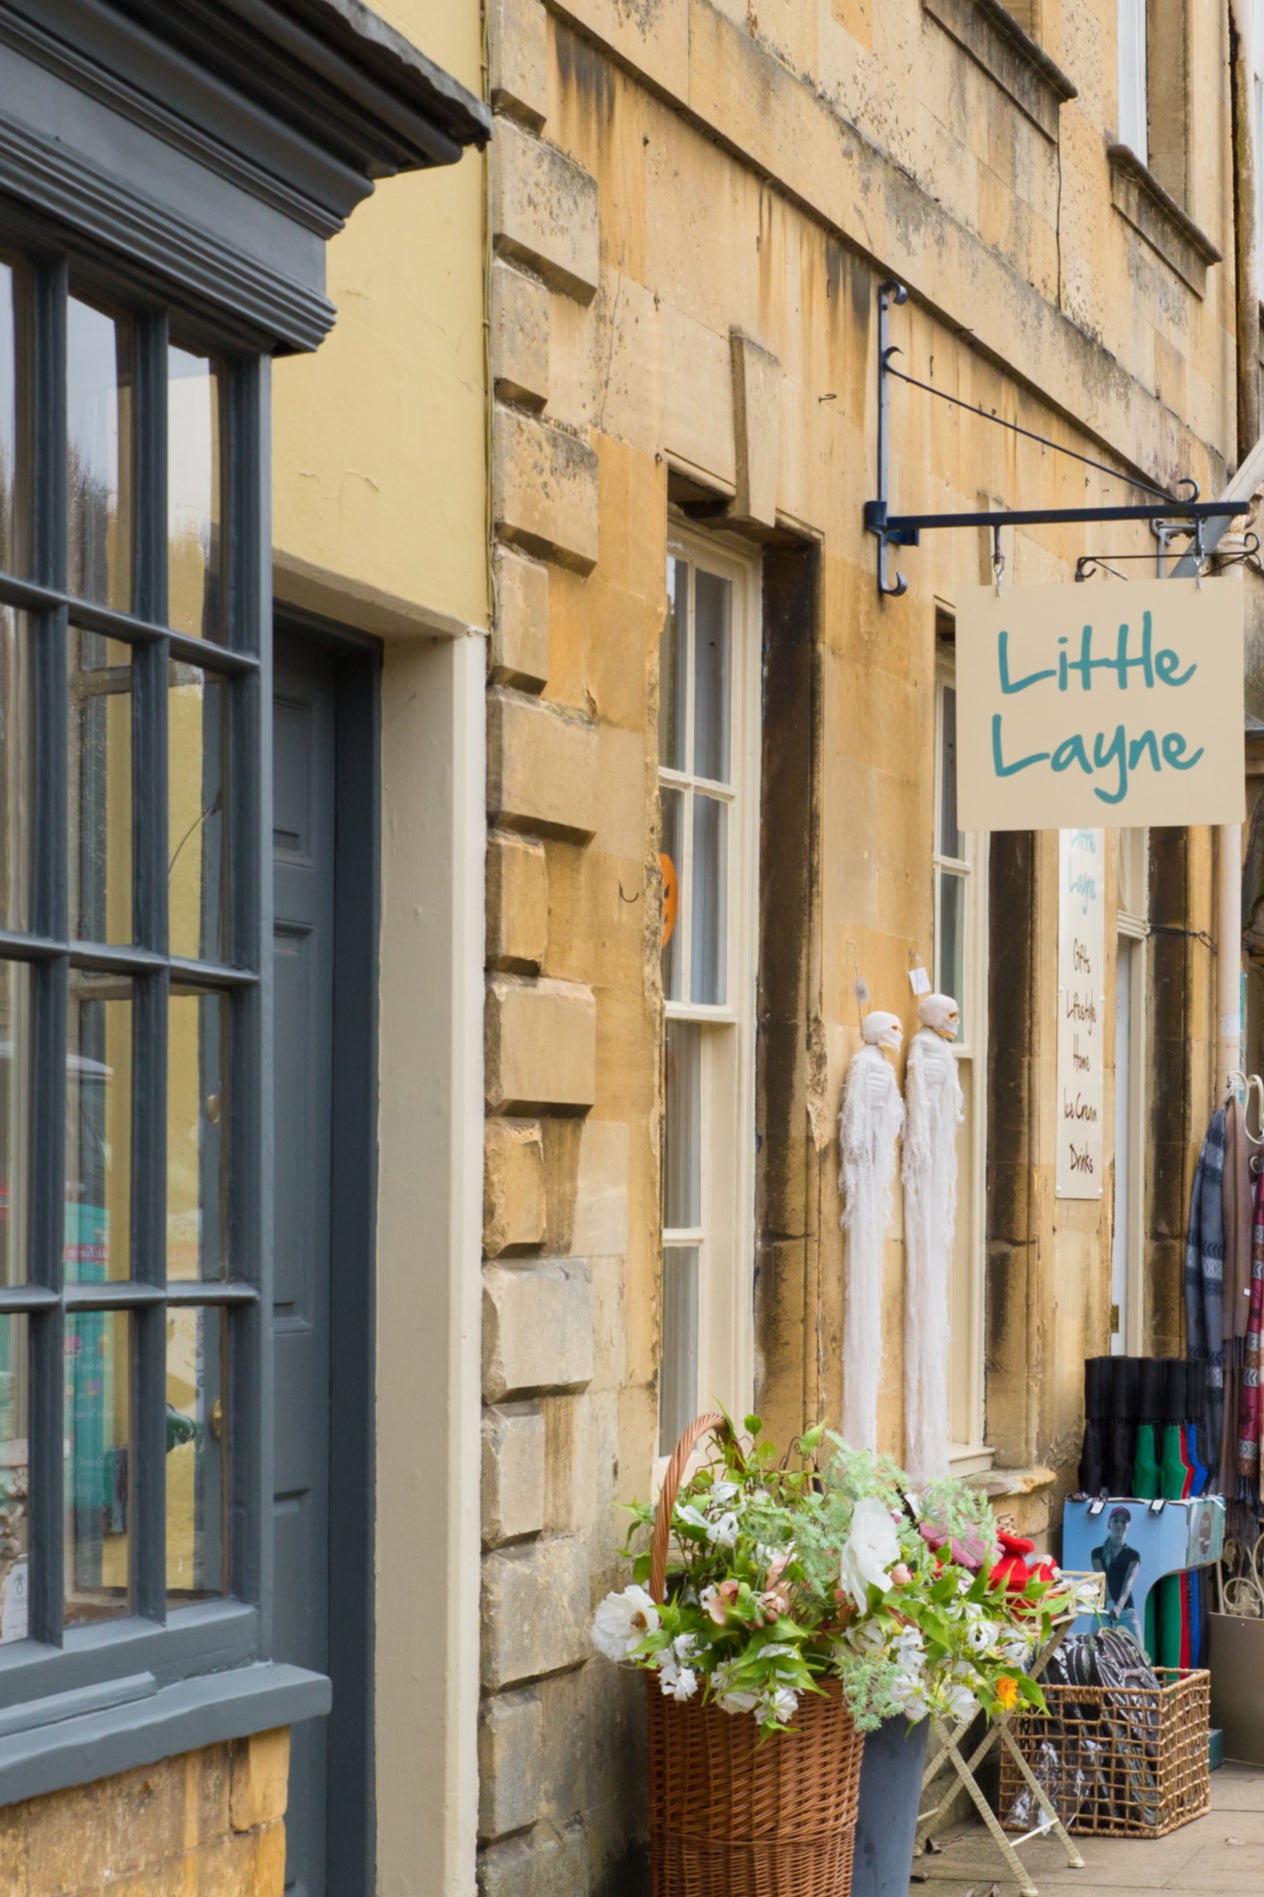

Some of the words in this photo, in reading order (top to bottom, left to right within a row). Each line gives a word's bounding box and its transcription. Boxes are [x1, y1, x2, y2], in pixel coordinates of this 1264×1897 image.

[998, 610, 1197, 694] Little
[992, 713, 1204, 804] Layne
[1068, 856, 1096, 915] Layne
[1073, 938, 1091, 974] Gifts
[1066, 989, 1096, 1036] Lifestyle
[1072, 1031, 1091, 1073] Home
[1075, 1091, 1098, 1122] Cream
[1069, 1141, 1094, 1174] Drinks
